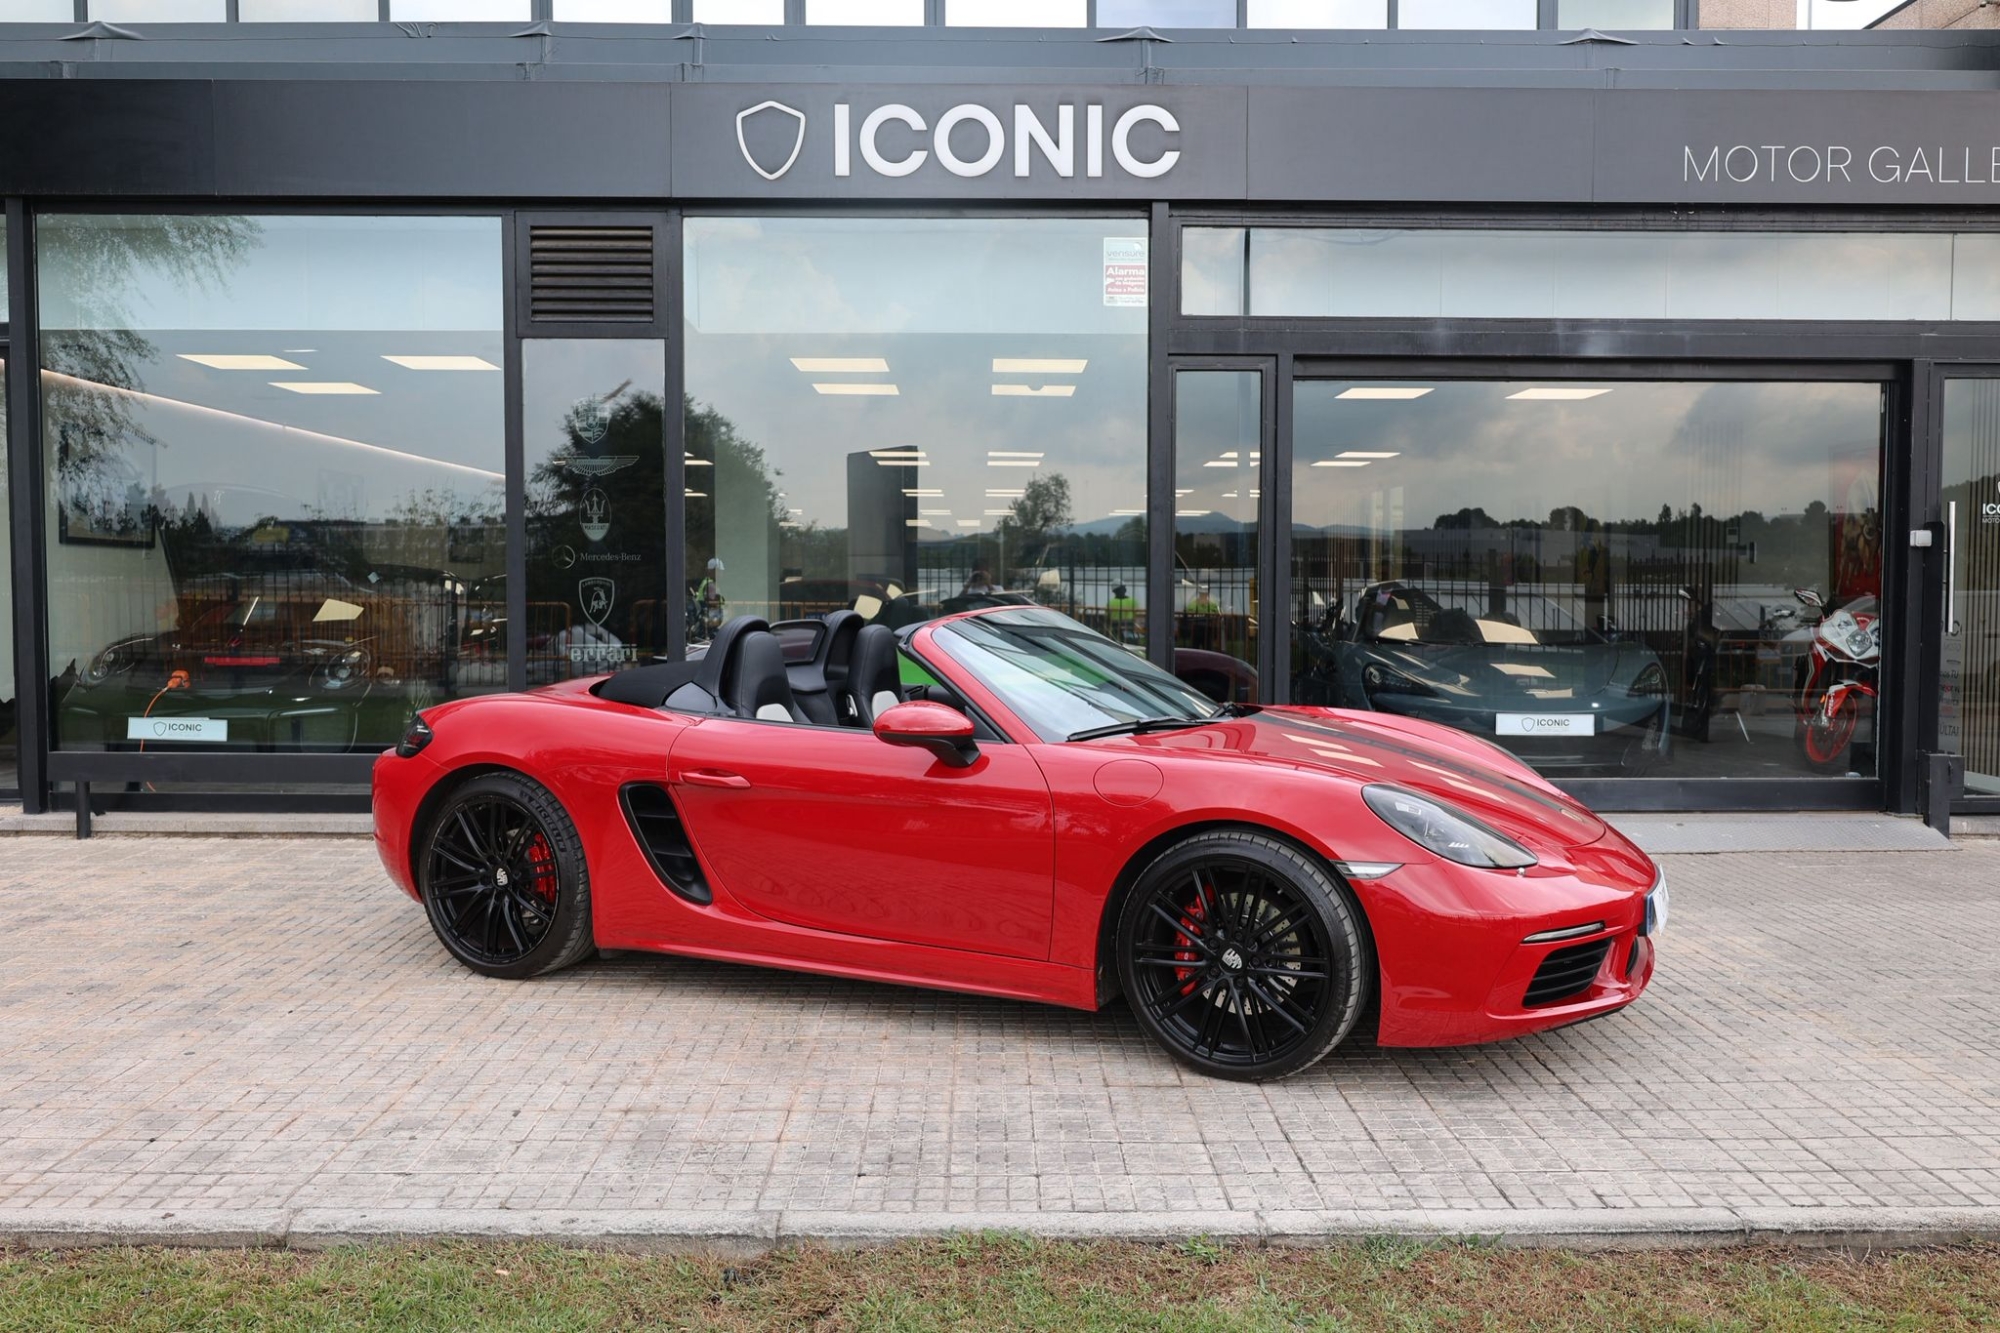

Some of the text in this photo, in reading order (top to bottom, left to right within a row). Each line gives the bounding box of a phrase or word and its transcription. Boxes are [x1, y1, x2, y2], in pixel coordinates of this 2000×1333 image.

[834, 103, 1181, 178] ICONIC
[1684, 145, 1851, 183] MOTOR
[1106, 267, 1145, 275] Alarma
[580, 552, 641, 561] Mercedes-Benz
[168, 723, 202, 731] ICONIC
[1536, 718, 1570, 727] ICONIC
